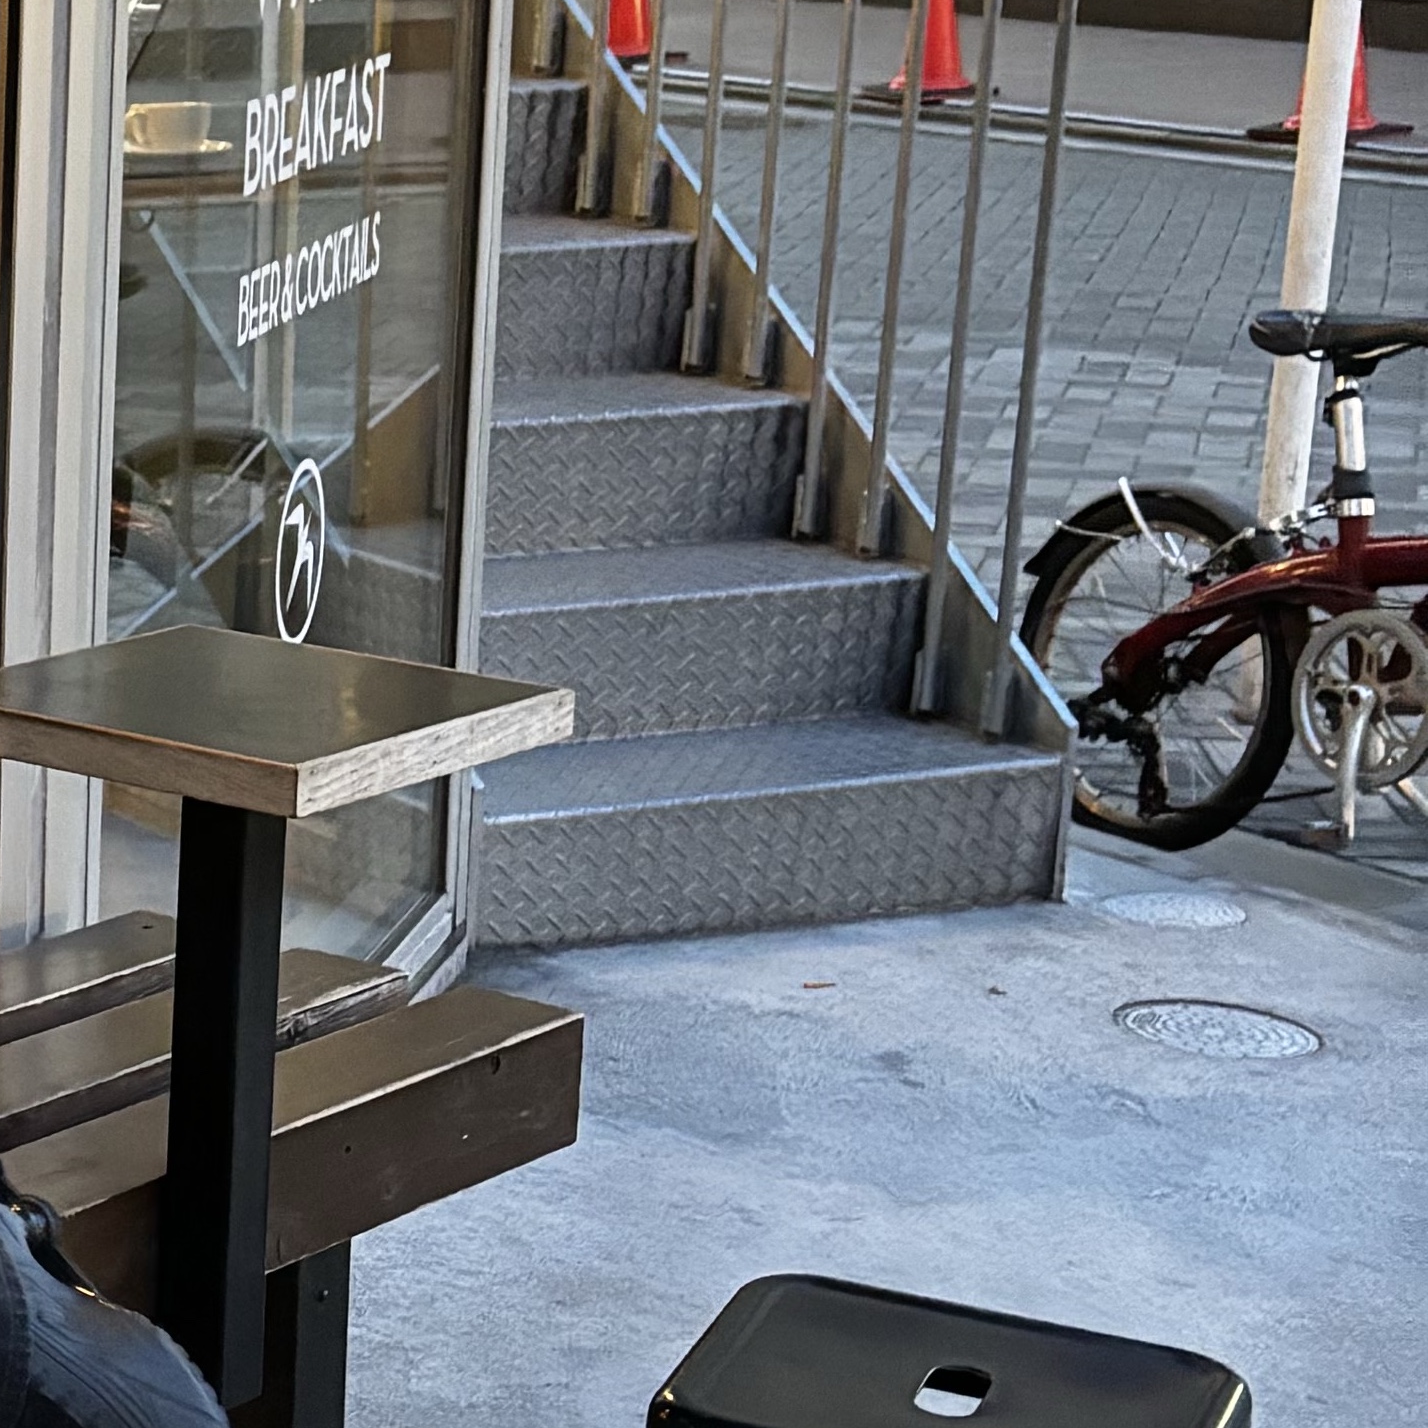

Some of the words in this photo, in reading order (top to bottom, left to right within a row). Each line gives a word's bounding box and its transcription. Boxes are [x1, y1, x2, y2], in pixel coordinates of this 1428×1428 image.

[243, 52, 391, 197] BREAKFAST
[237, 260, 280, 347] BEER
[295, 210, 381, 316] COCKTAILS
